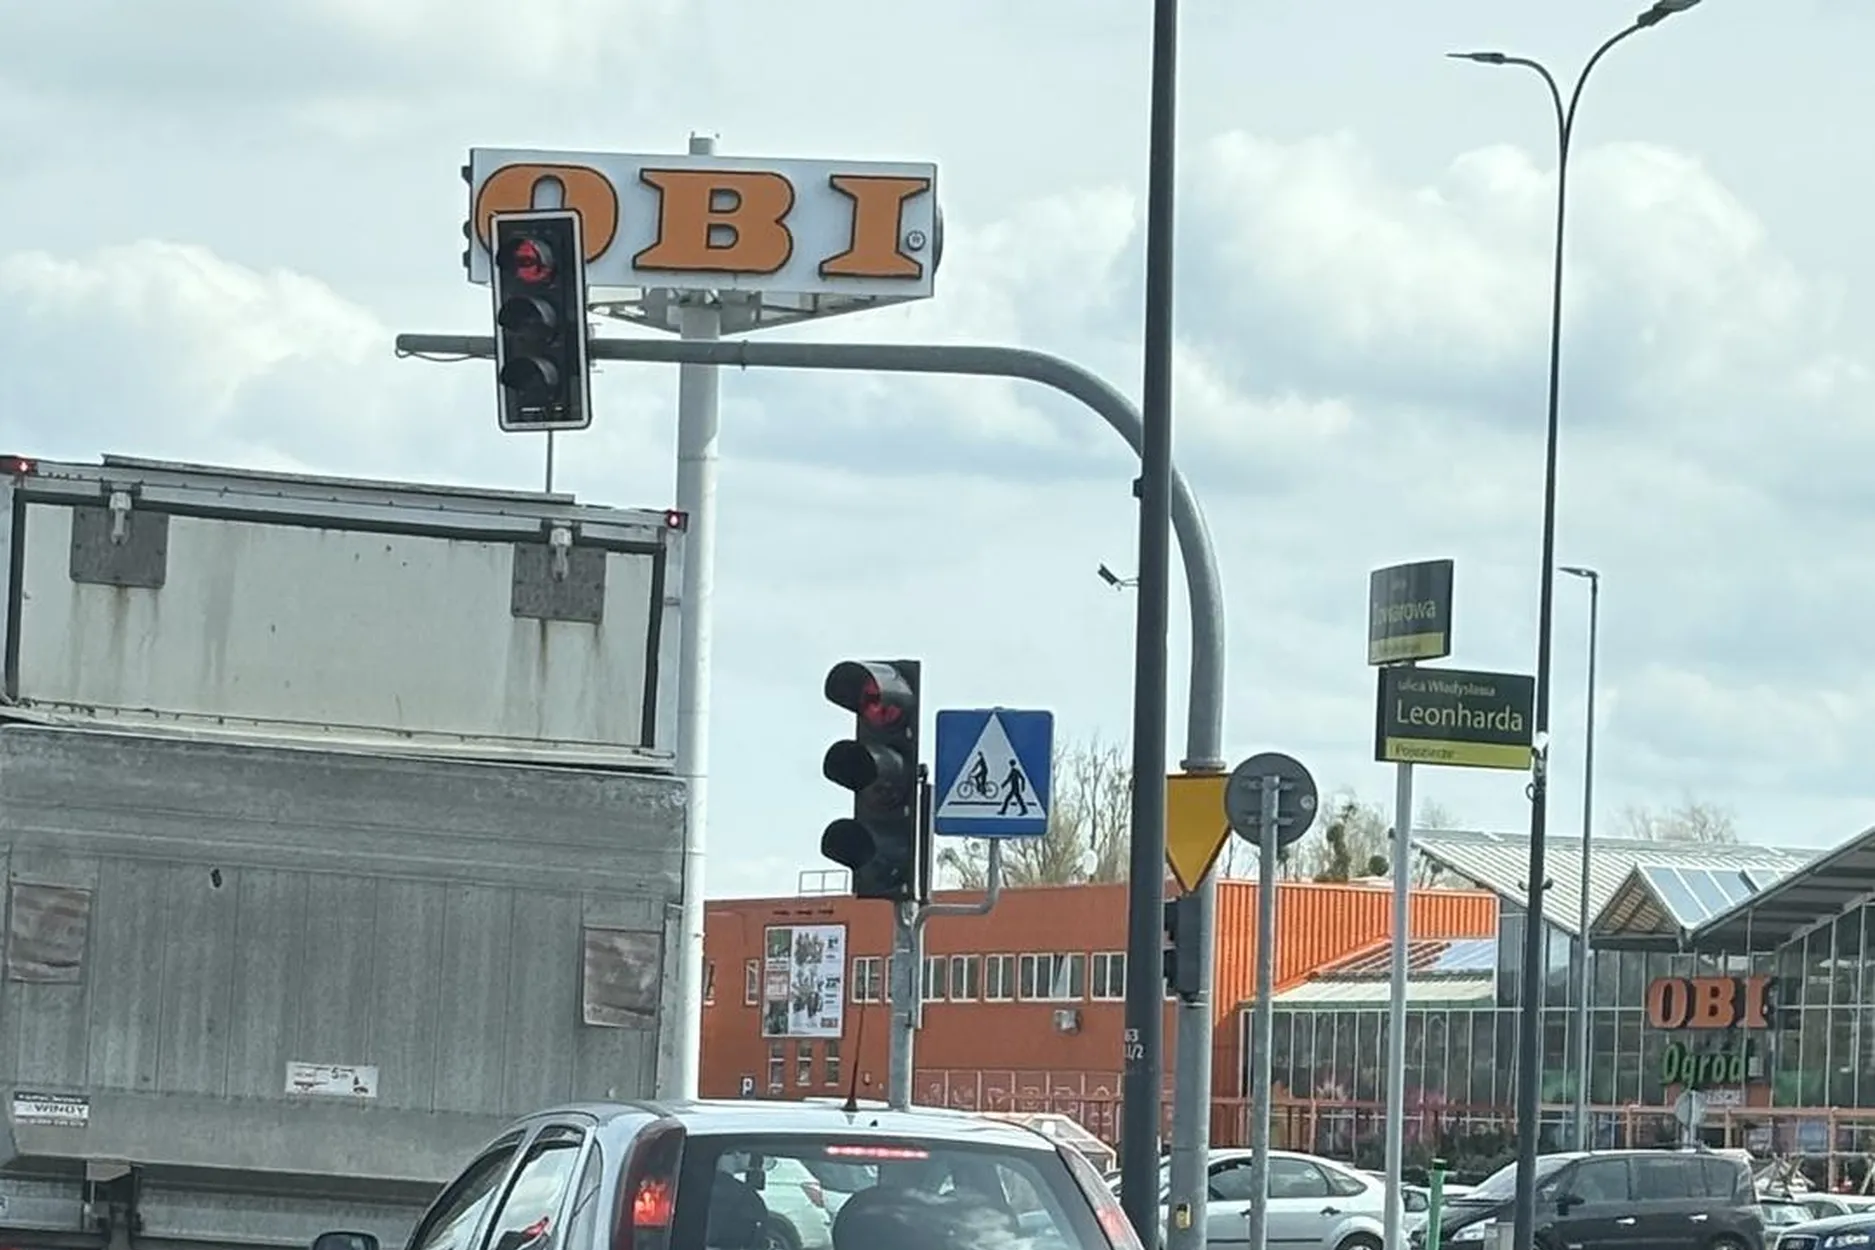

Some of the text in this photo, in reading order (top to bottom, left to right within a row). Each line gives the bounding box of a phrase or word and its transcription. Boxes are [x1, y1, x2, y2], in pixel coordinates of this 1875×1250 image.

[475, 163, 931, 279] OBI
[1397, 699, 1523, 731] Leonharda
[1648, 977, 1770, 1029] OBI
[742, 1077, 753, 1096] P
